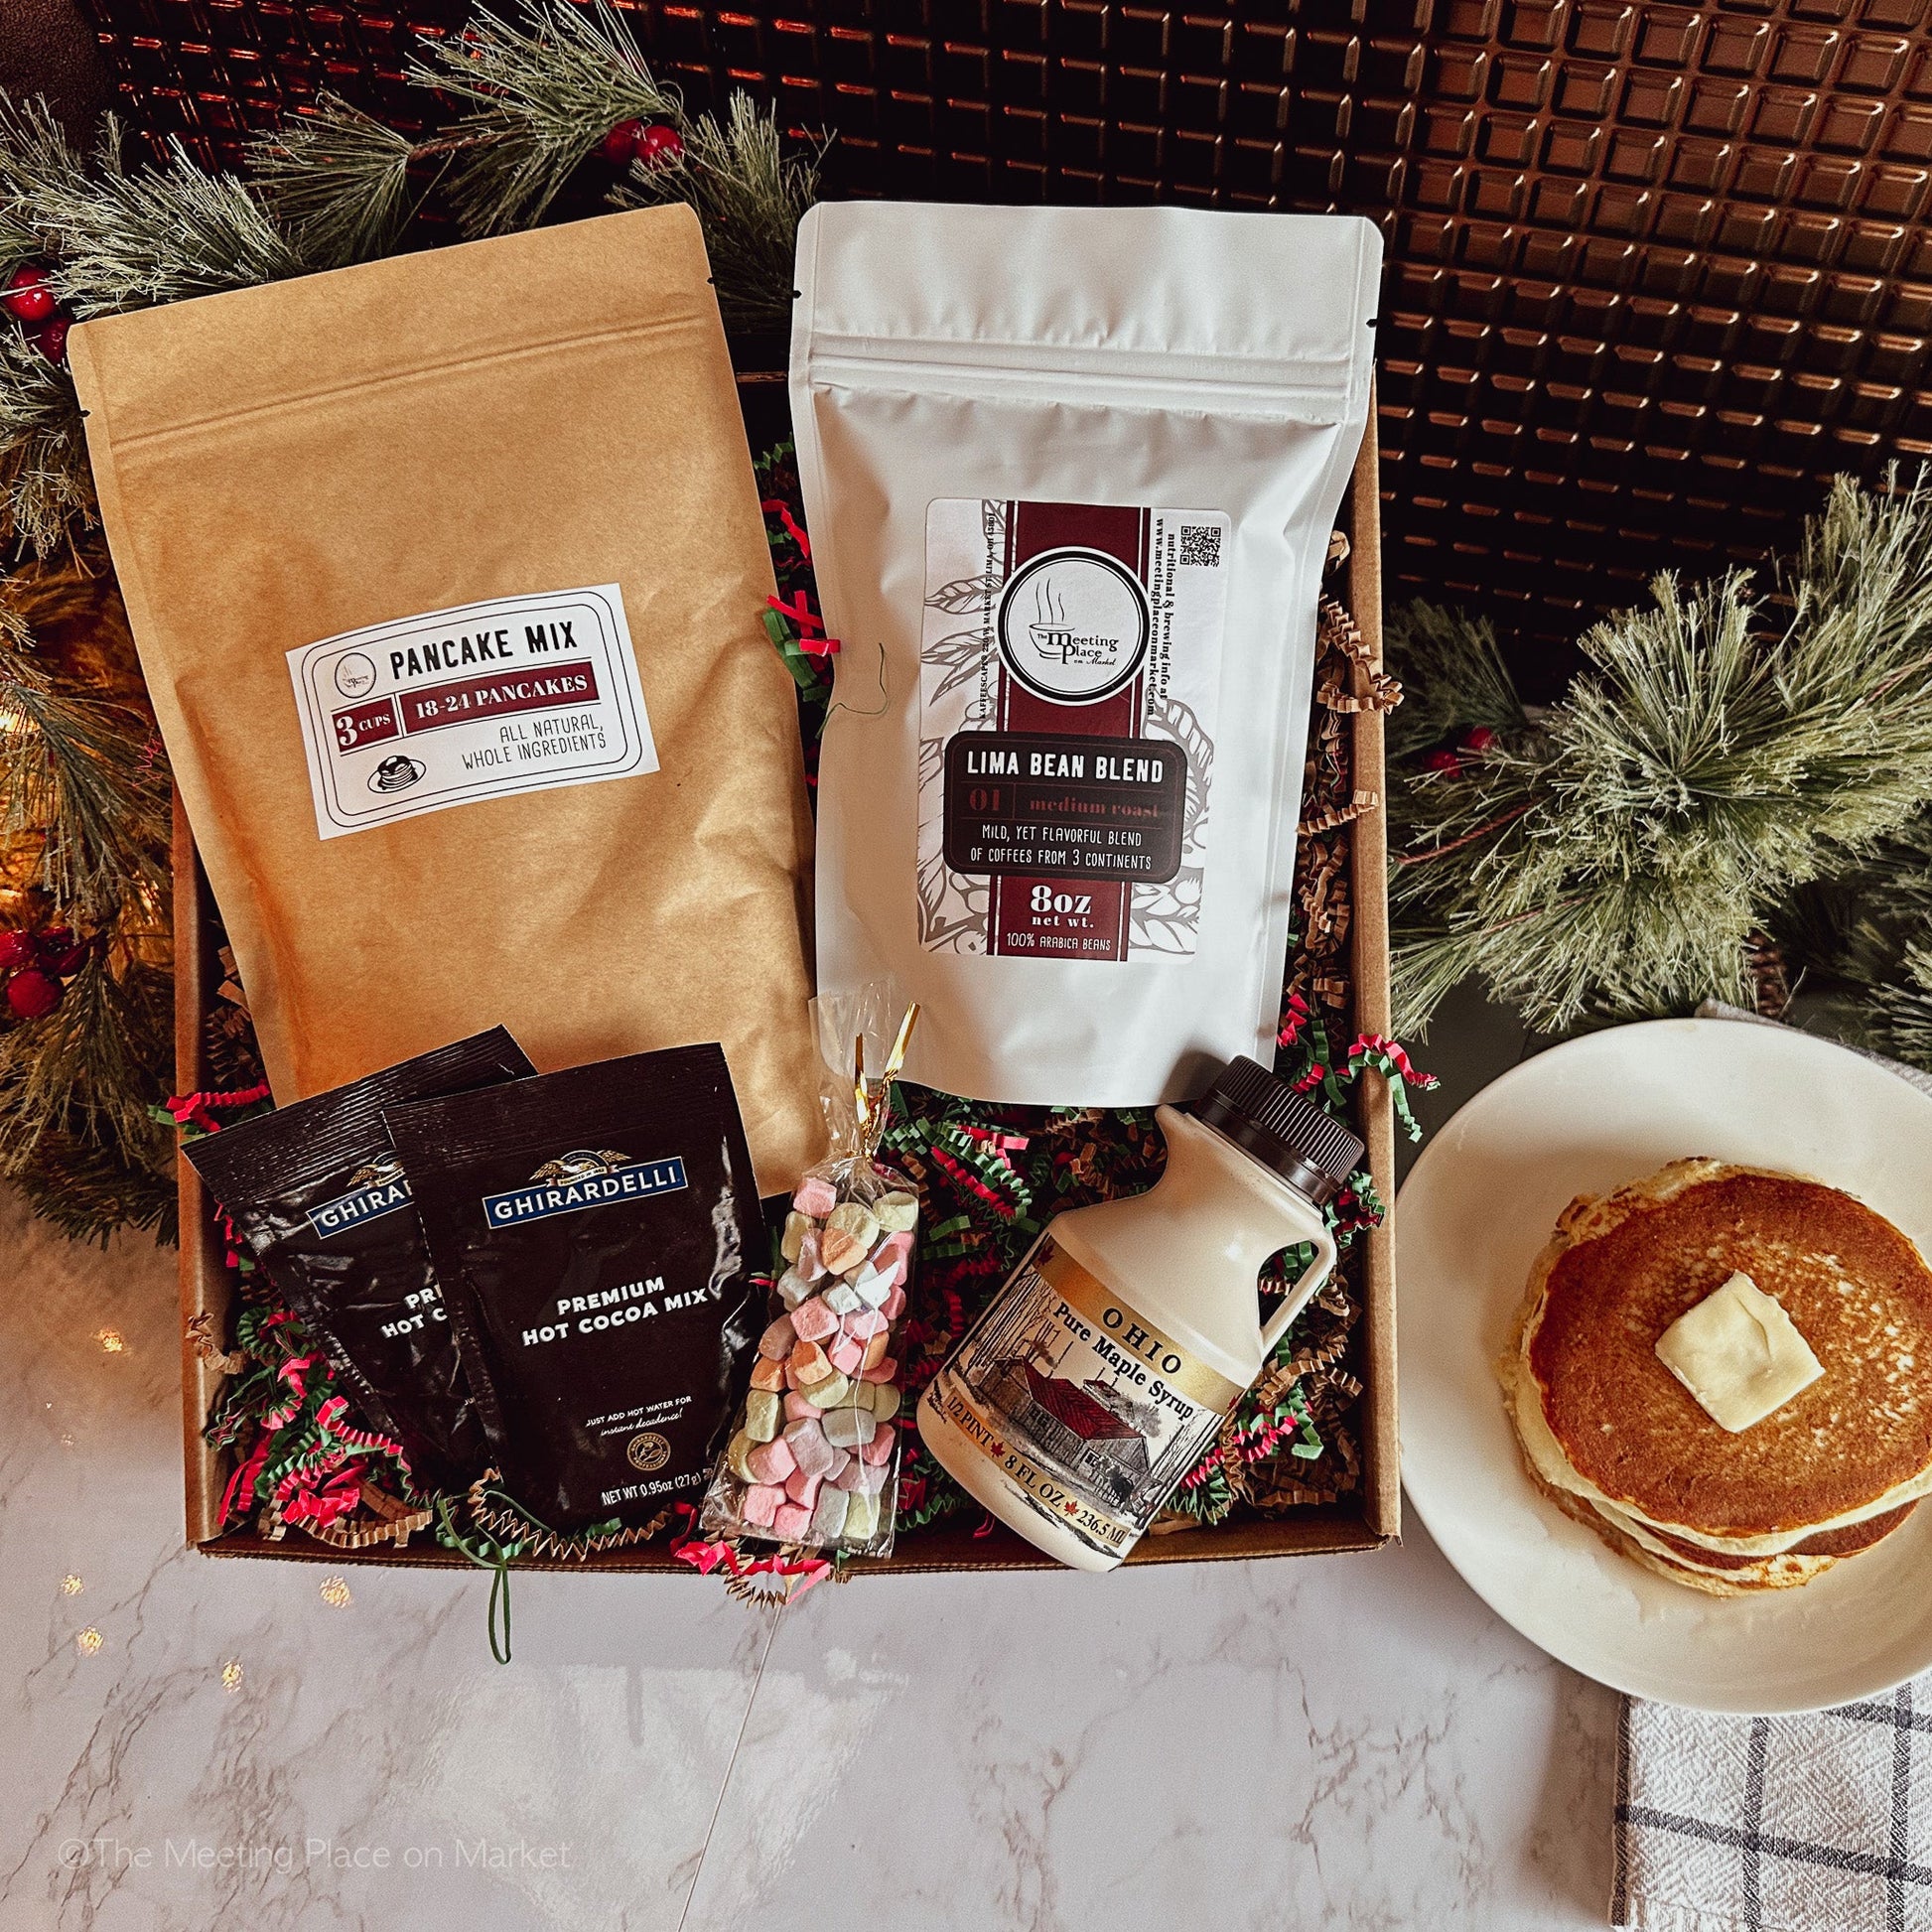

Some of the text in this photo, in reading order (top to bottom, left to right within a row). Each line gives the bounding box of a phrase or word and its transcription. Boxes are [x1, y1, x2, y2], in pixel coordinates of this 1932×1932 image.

[1148, 518, 1164, 716] www.meetingplaceonmarket.com
[1160, 534, 1176, 699] nutritional & brewing info at
[390, 621, 578, 679] PANCAKE MIX
[416, 674, 588, 720] 18-24 PANCAKES
[336, 713, 391, 747] 3 CUPS
[499, 713, 604, 744] ALL NATURAL,
[462, 733, 607, 770] WHOLE INGREDIENTS
[967, 751, 1164, 782] LIMA BEAN BLEND
[1030, 796, 1160, 818] medium roast
[983, 825, 1142, 847] MILD, YET FLAVORFUL BLEND
[971, 848, 1152, 870] OF COFFEES FROM 3 CONTINENTS
[1031, 886, 1092, 914] 8oz
[1032, 915, 1094, 929] net wt.
[1007, 933, 1111, 951] 100% ARABICA BEANS
[494, 1166, 679, 1221] GHIRARDELLI
[557, 1277, 665, 1315] PREMIUM
[381, 1314, 425, 1338] HOT
[522, 1287, 709, 1347] HOT COCOA MIX
[1102, 1307, 1183, 1374] OHIO
[1052, 1302, 1193, 1421] Pure Maple Syrup
[586, 1395, 693, 1428] JUST ADD HOT WATER FOR
[600, 1408, 684, 1436] instant decadence!
[946, 1397, 963, 1417] 1/2
[960, 1410, 995, 1448] PINT
[1005, 1453, 1017, 1469] 8
[1015, 1465, 1038, 1490] FL
[1038, 1481, 1066, 1507] OZ
[1076, 1510, 1110, 1535] 236.5
[601, 1471, 701, 1507] NET WT 0.95oz (27g)
